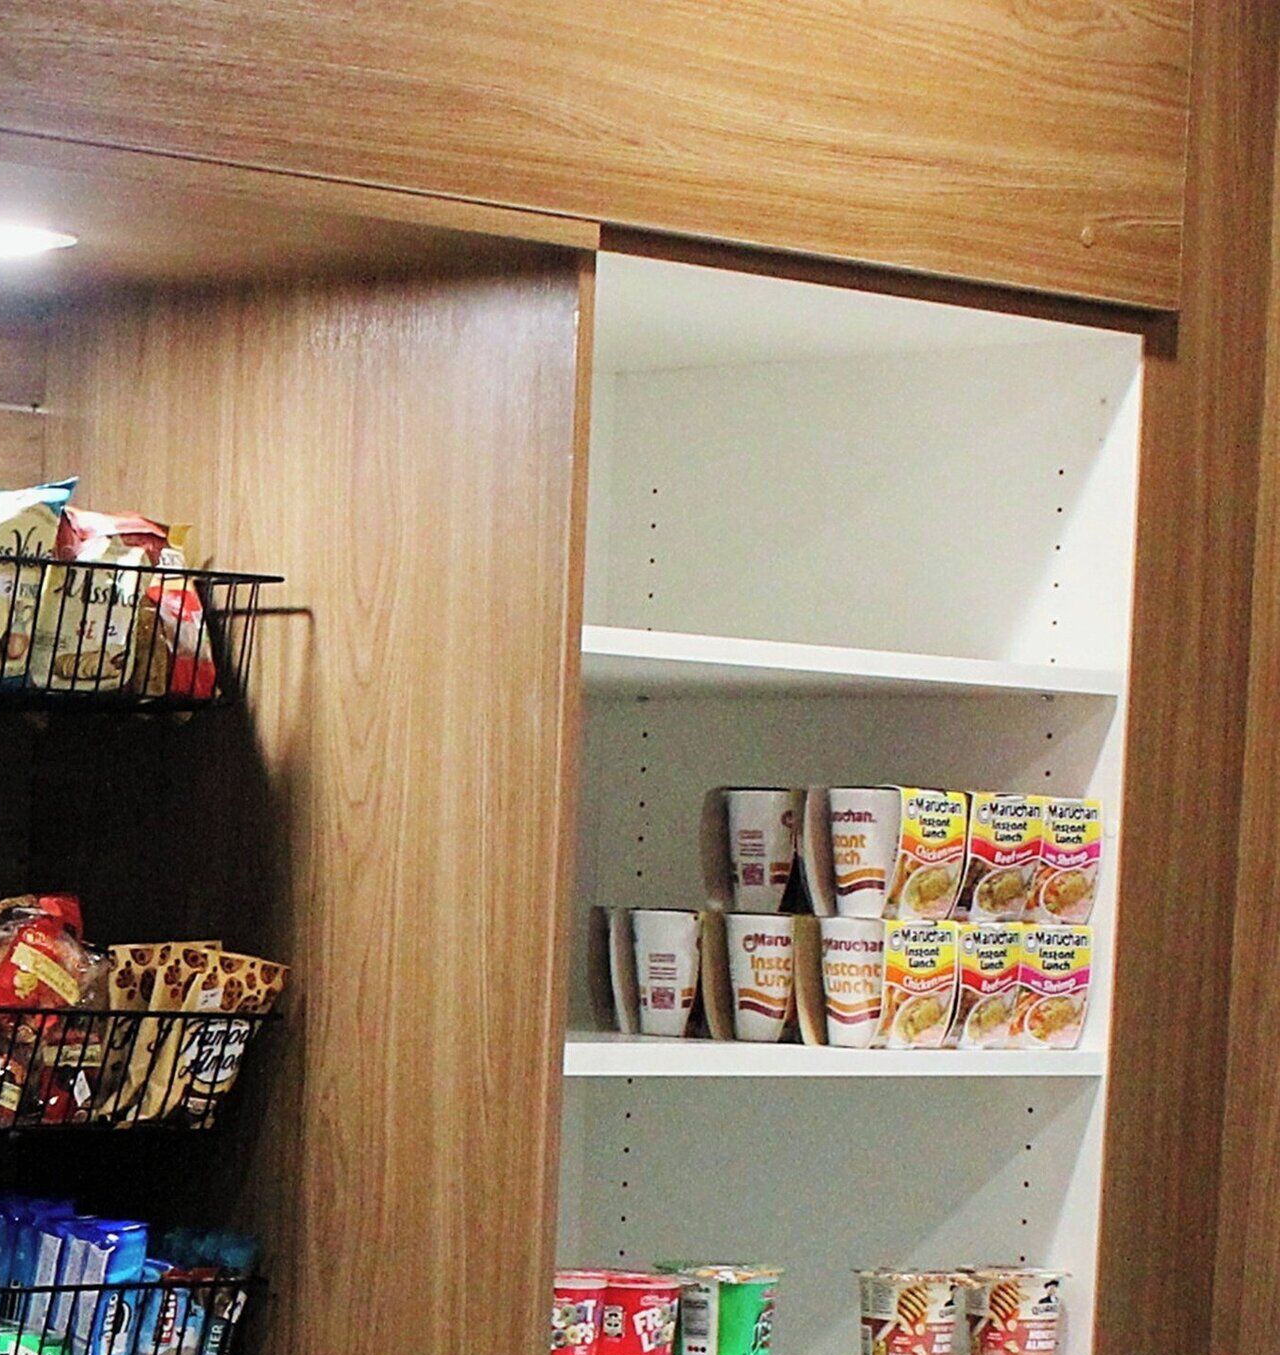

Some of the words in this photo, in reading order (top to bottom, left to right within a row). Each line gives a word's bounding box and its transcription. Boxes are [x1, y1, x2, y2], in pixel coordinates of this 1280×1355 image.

[916, 797, 961, 814] Maruchan
[989, 802, 1040, 818] Maruchan
[1048, 804, 1098, 820] Maruchan
[921, 826, 947, 839] Lunch
[995, 831, 1023, 843] Lunch
[1055, 833, 1083, 844] Lunch
[901, 927, 952, 943] Maruchan
[971, 928, 1020, 945] Maruchan
[1034, 931, 1088, 947] Maruchan
[909, 957, 937, 968] Lunch
[980, 959, 1006, 970] Lunch
[1042, 960, 1072, 971] Lunch
